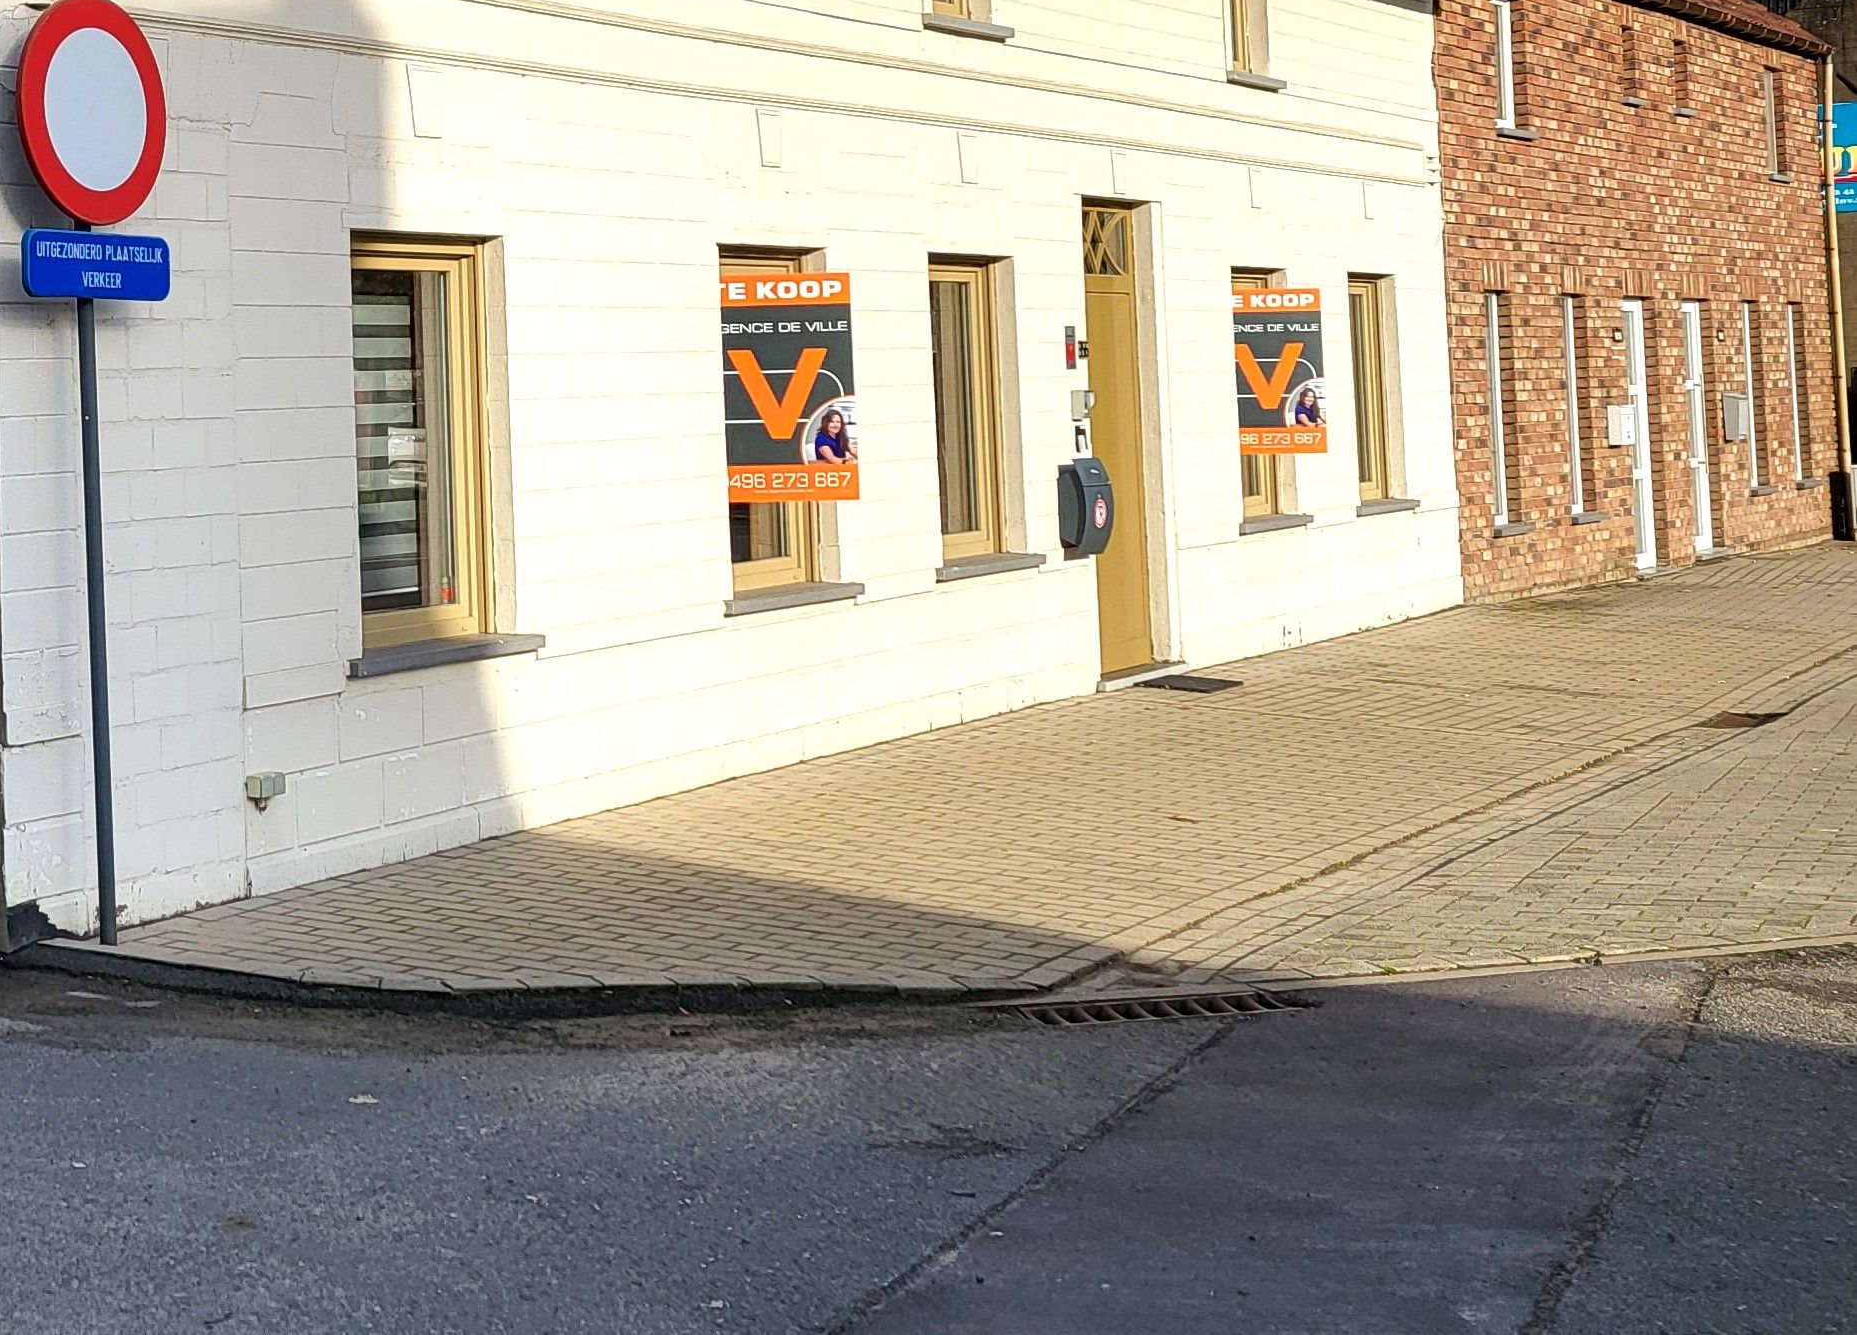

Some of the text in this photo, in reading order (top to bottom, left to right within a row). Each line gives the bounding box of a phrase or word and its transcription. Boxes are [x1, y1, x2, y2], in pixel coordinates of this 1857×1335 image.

[36, 240, 163, 264] UITGEZONDERD PLAATSELIJK
[82, 270, 122, 289] VERKEER
[756, 280, 842, 300] KOOP
[1250, 293, 1315, 308] KOOP
[778, 322, 801, 333] DE
[804, 320, 849, 332] VILLE
[1267, 323, 1285, 332] DE
[1286, 323, 1320, 332] VILLE
[726, 347, 829, 440] V
[1262, 433, 1291, 445] 273
[1294, 432, 1322, 444] 667
[771, 472, 809, 489] 273
[814, 471, 852, 488] 667
